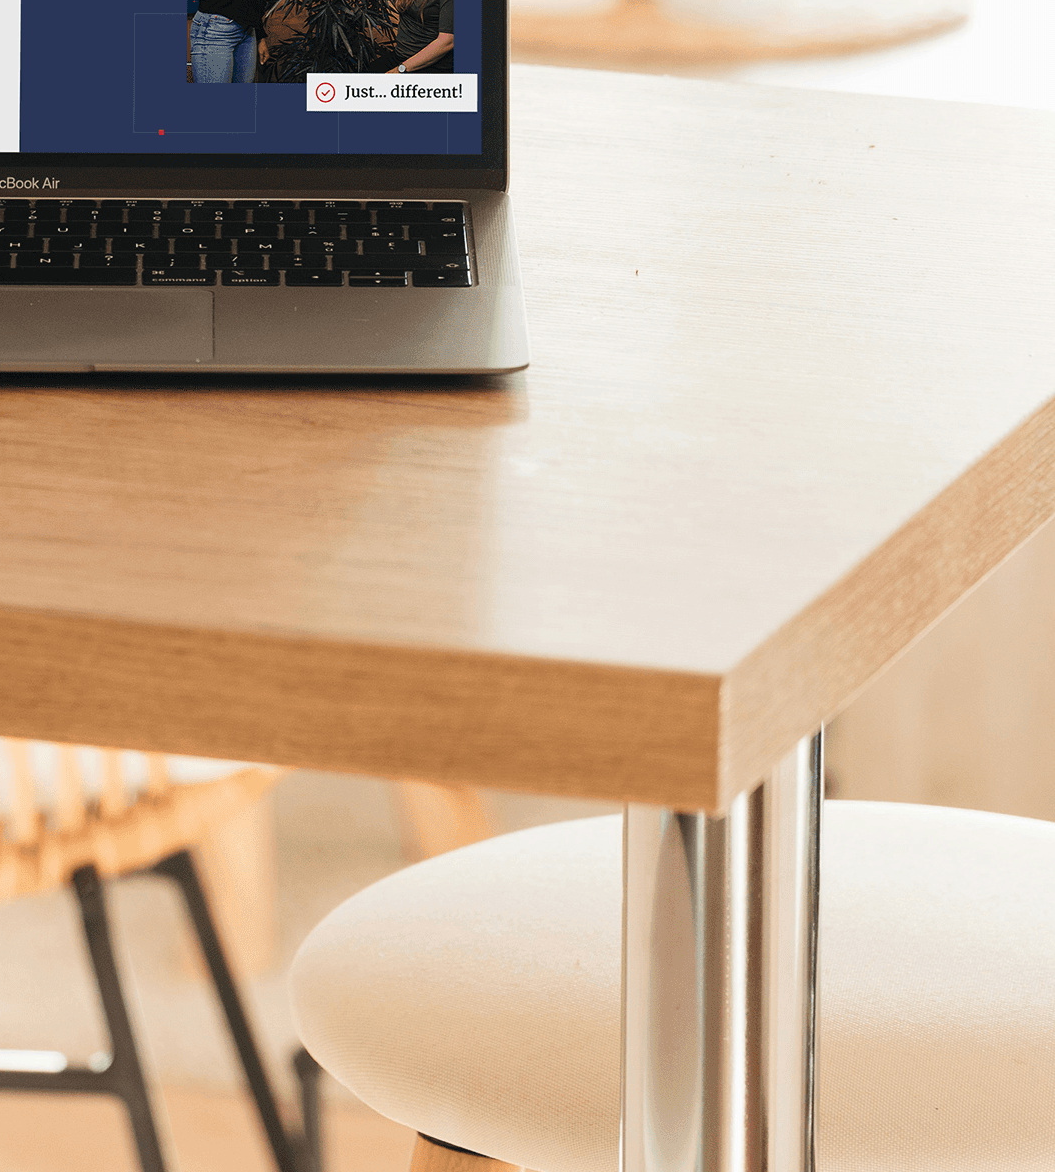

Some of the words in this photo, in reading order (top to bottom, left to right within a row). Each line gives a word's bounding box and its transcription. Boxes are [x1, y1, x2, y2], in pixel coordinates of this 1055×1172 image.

[345, 85, 386, 100] Just...
[391, 84, 462, 98] different!
[42, 177, 60, 189] Air
